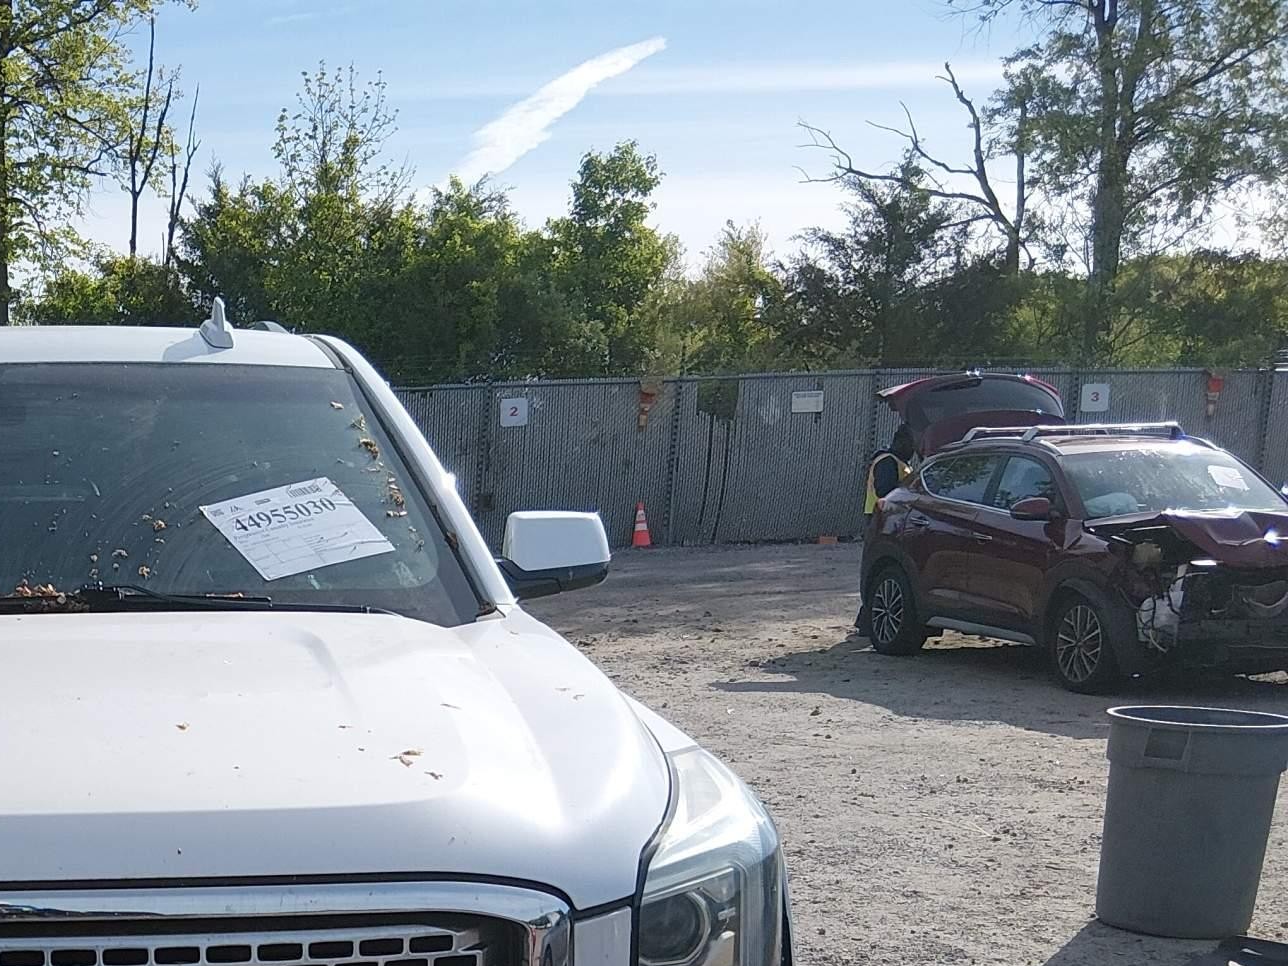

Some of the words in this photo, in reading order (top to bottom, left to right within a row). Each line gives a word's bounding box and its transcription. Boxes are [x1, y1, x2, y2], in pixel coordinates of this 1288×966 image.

[1091, 391, 1100, 402] 3
[509, 406, 519, 417] 2
[235, 498, 337, 532] 44955030
